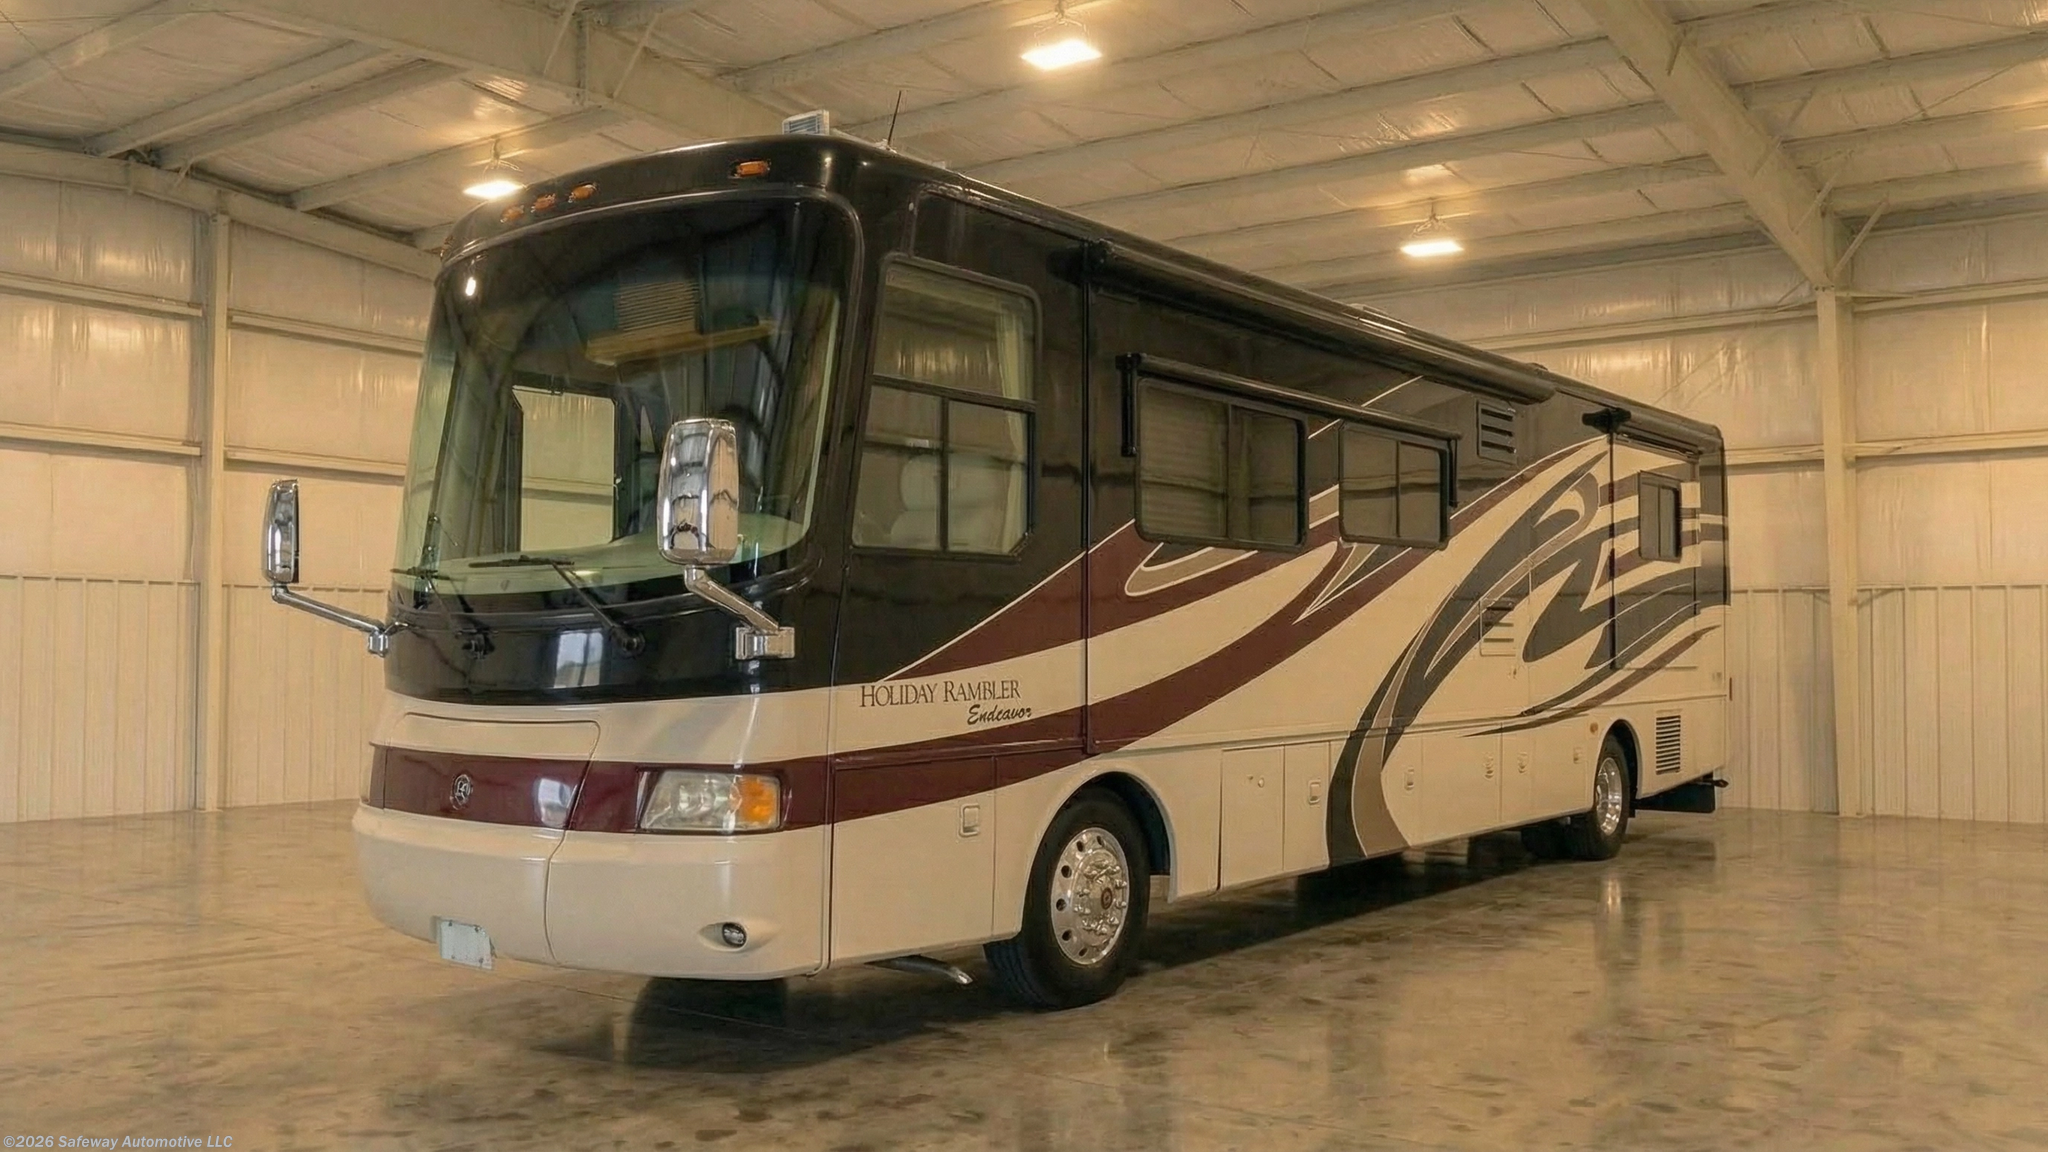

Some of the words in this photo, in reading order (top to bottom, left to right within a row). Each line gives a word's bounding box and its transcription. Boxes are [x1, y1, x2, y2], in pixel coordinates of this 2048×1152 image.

[860, 683, 938, 707] HOLIDAY
[943, 679, 1022, 703] RAMBLER
[967, 704, 1032, 726] Endeavor
